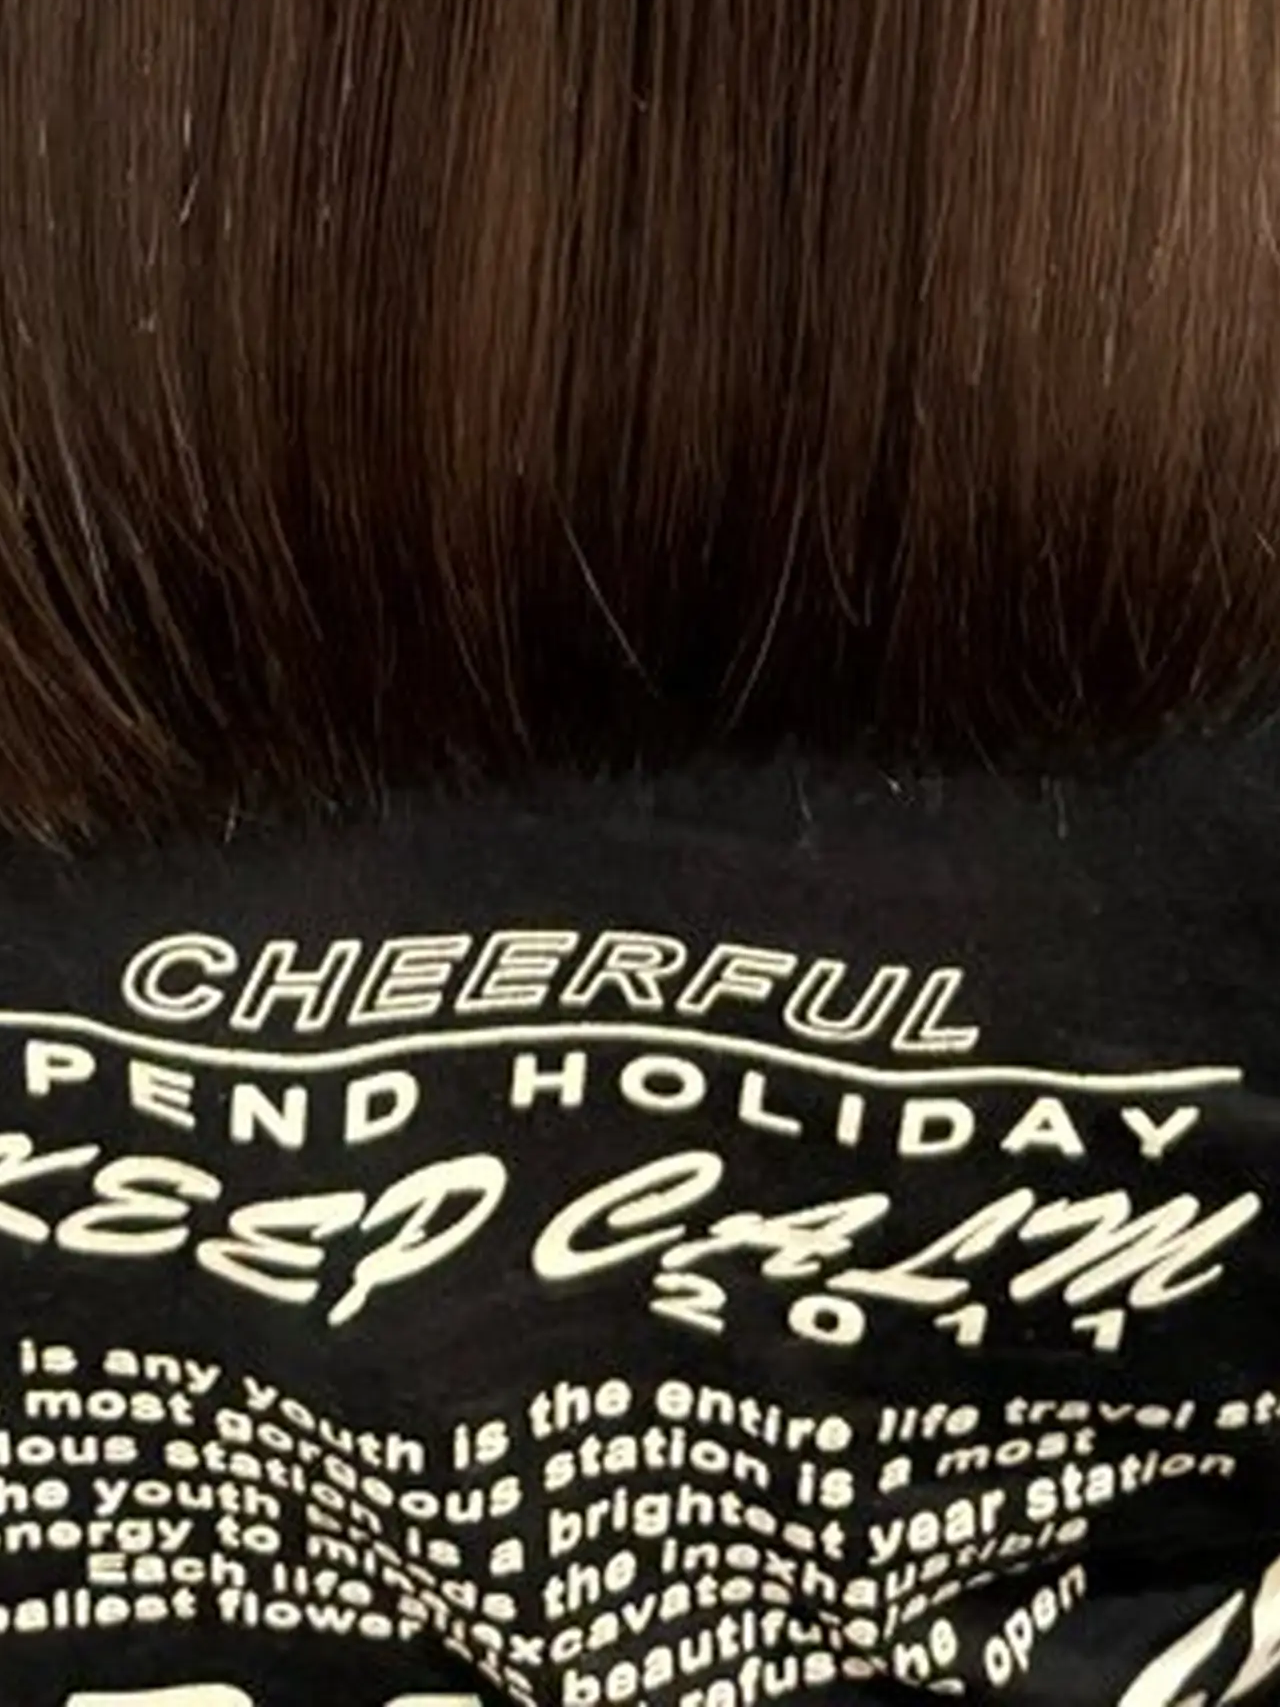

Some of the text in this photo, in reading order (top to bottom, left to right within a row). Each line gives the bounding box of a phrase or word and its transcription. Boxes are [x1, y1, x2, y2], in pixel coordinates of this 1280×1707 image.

[122, 930, 980, 1053] CHEERFUL
[510, 1051, 1201, 1158] HOLIDAY
[532, 1150, 1261, 1309] CALM
[649, 1271, 1127, 1352] 2011
[20, 1338, 78, 1375] is
[104, 1348, 220, 1393] any
[242, 1375, 424, 1474] youth
[453, 1419, 510, 1470] is
[528, 1378, 633, 1440] the
[654, 1378, 854, 1453] entire
[877, 1403, 980, 1445] life
[1004, 1397, 1196, 1431] travel
[25, 1390, 196, 1426] most
[214, 1407, 523, 1524] gorgeous
[544, 1426, 770, 1491] station
[796, 1460, 856, 1510] is
[877, 1455, 913, 1494] a
[935, 1427, 1097, 1478] most
[93, 1479, 282, 1520] youth
[542, 1550, 638, 1621] the
[215, 1512, 282, 1555] to
[405, 1525, 462, 1569] is
[488, 1536, 525, 1578] a
[548, 1483, 846, 1559] brightest
[868, 1488, 1007, 1567] year
[1025, 1449, 1237, 1522] station
[87, 1551, 247, 1588] Each
[273, 1561, 373, 1606] life
[218, 1587, 423, 1641] flower
[983, 1561, 1088, 1686] open
